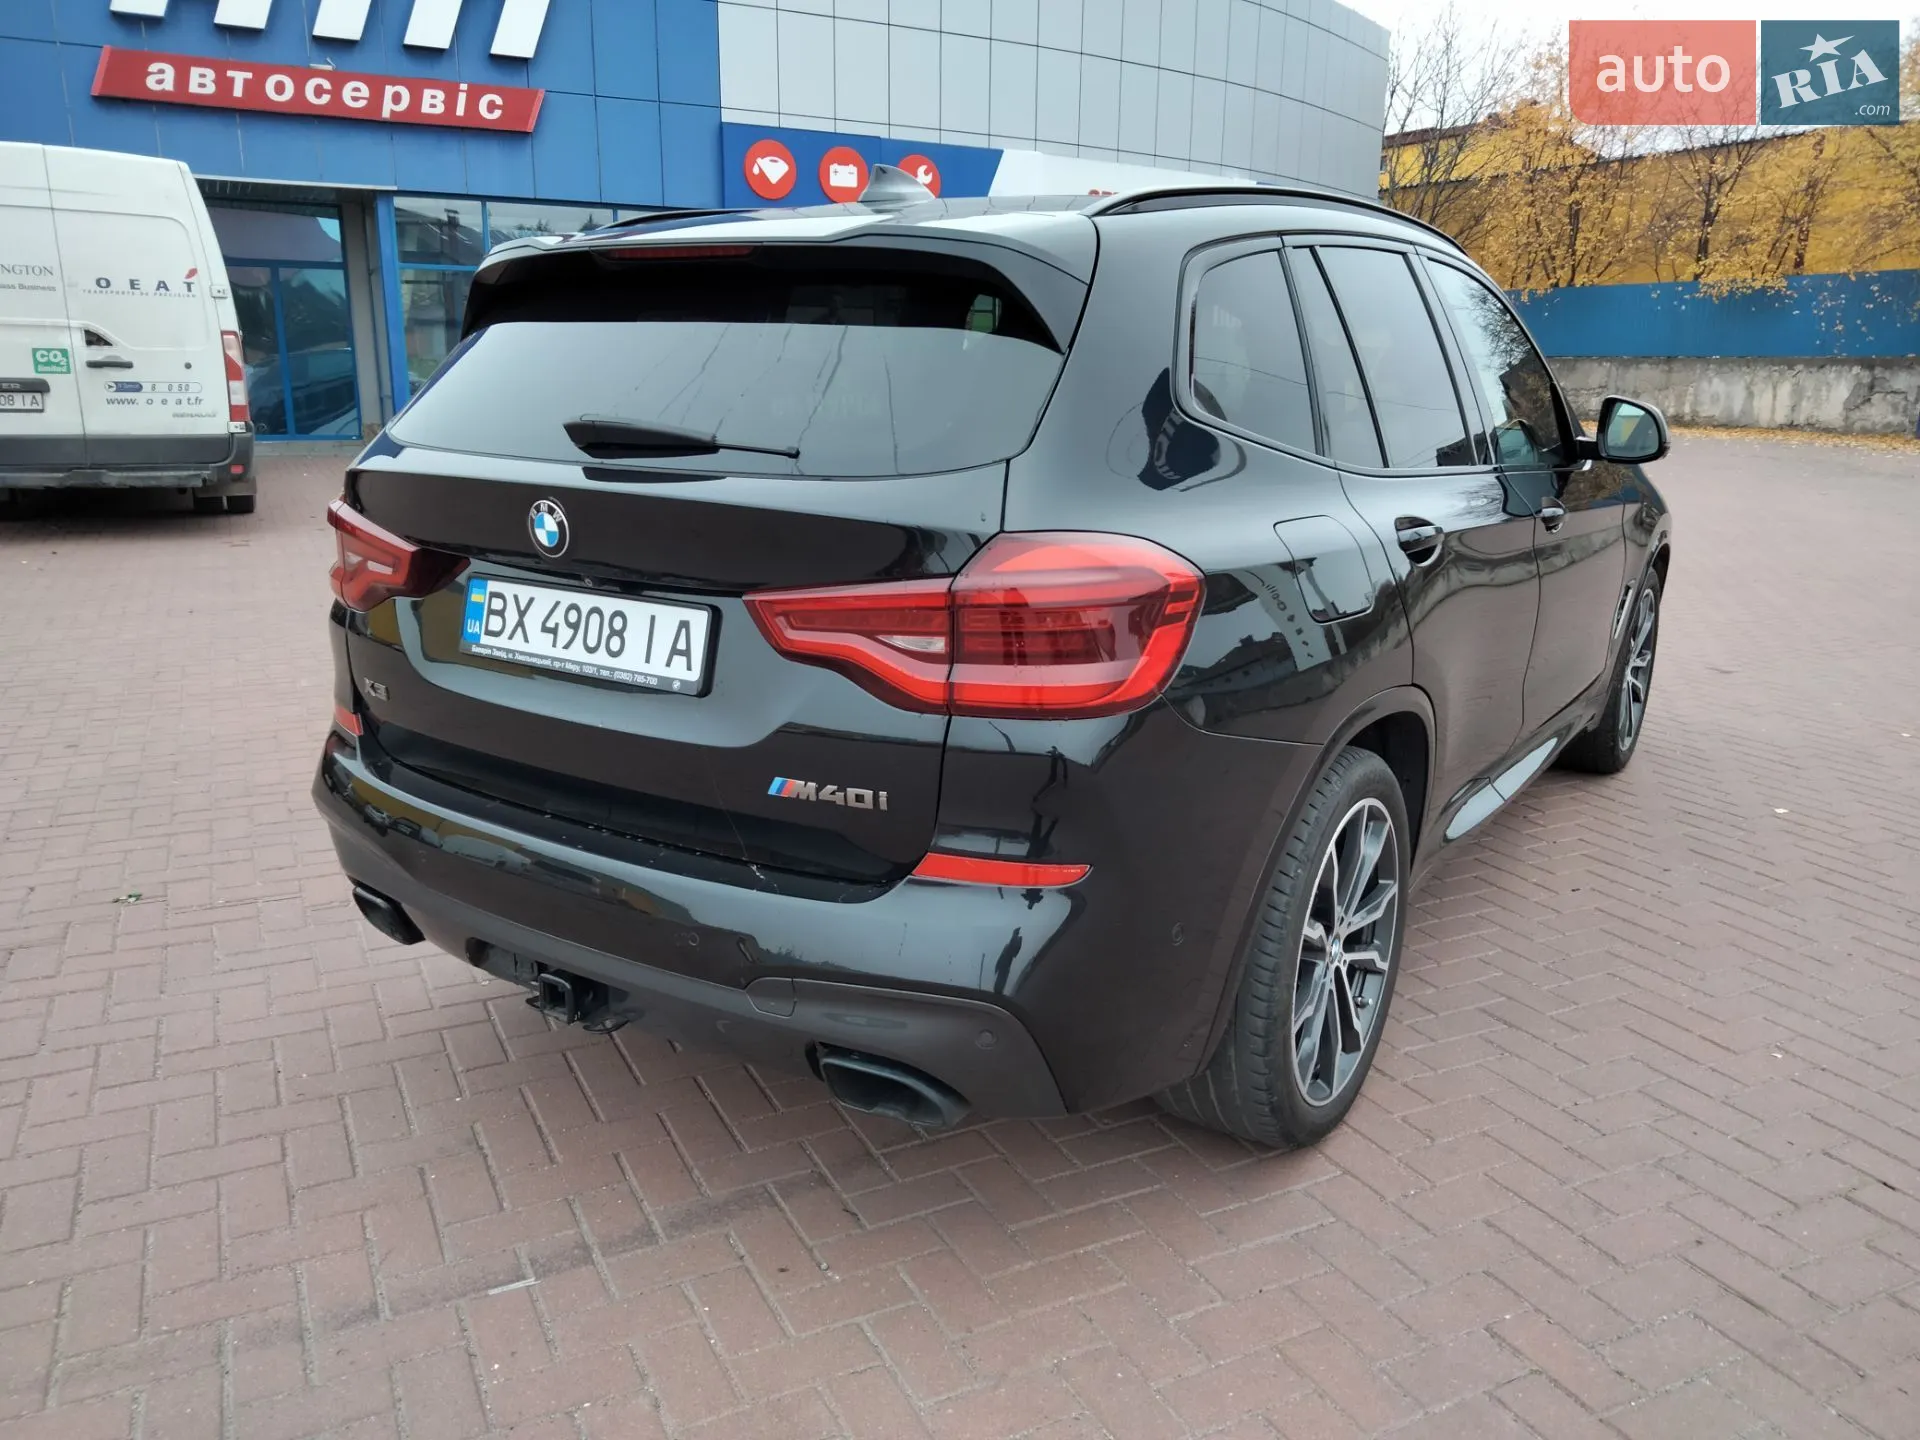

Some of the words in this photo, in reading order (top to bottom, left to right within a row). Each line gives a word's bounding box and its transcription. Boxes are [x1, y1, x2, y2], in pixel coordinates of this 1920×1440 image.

[145, 61, 505, 119] автосервіс
[467, 620, 480, 635] UA
[484, 590, 535, 644] BX
[540, 600, 628, 659] 4908
[644, 614, 693, 672] IA
[789, 780, 888, 811] M40i
